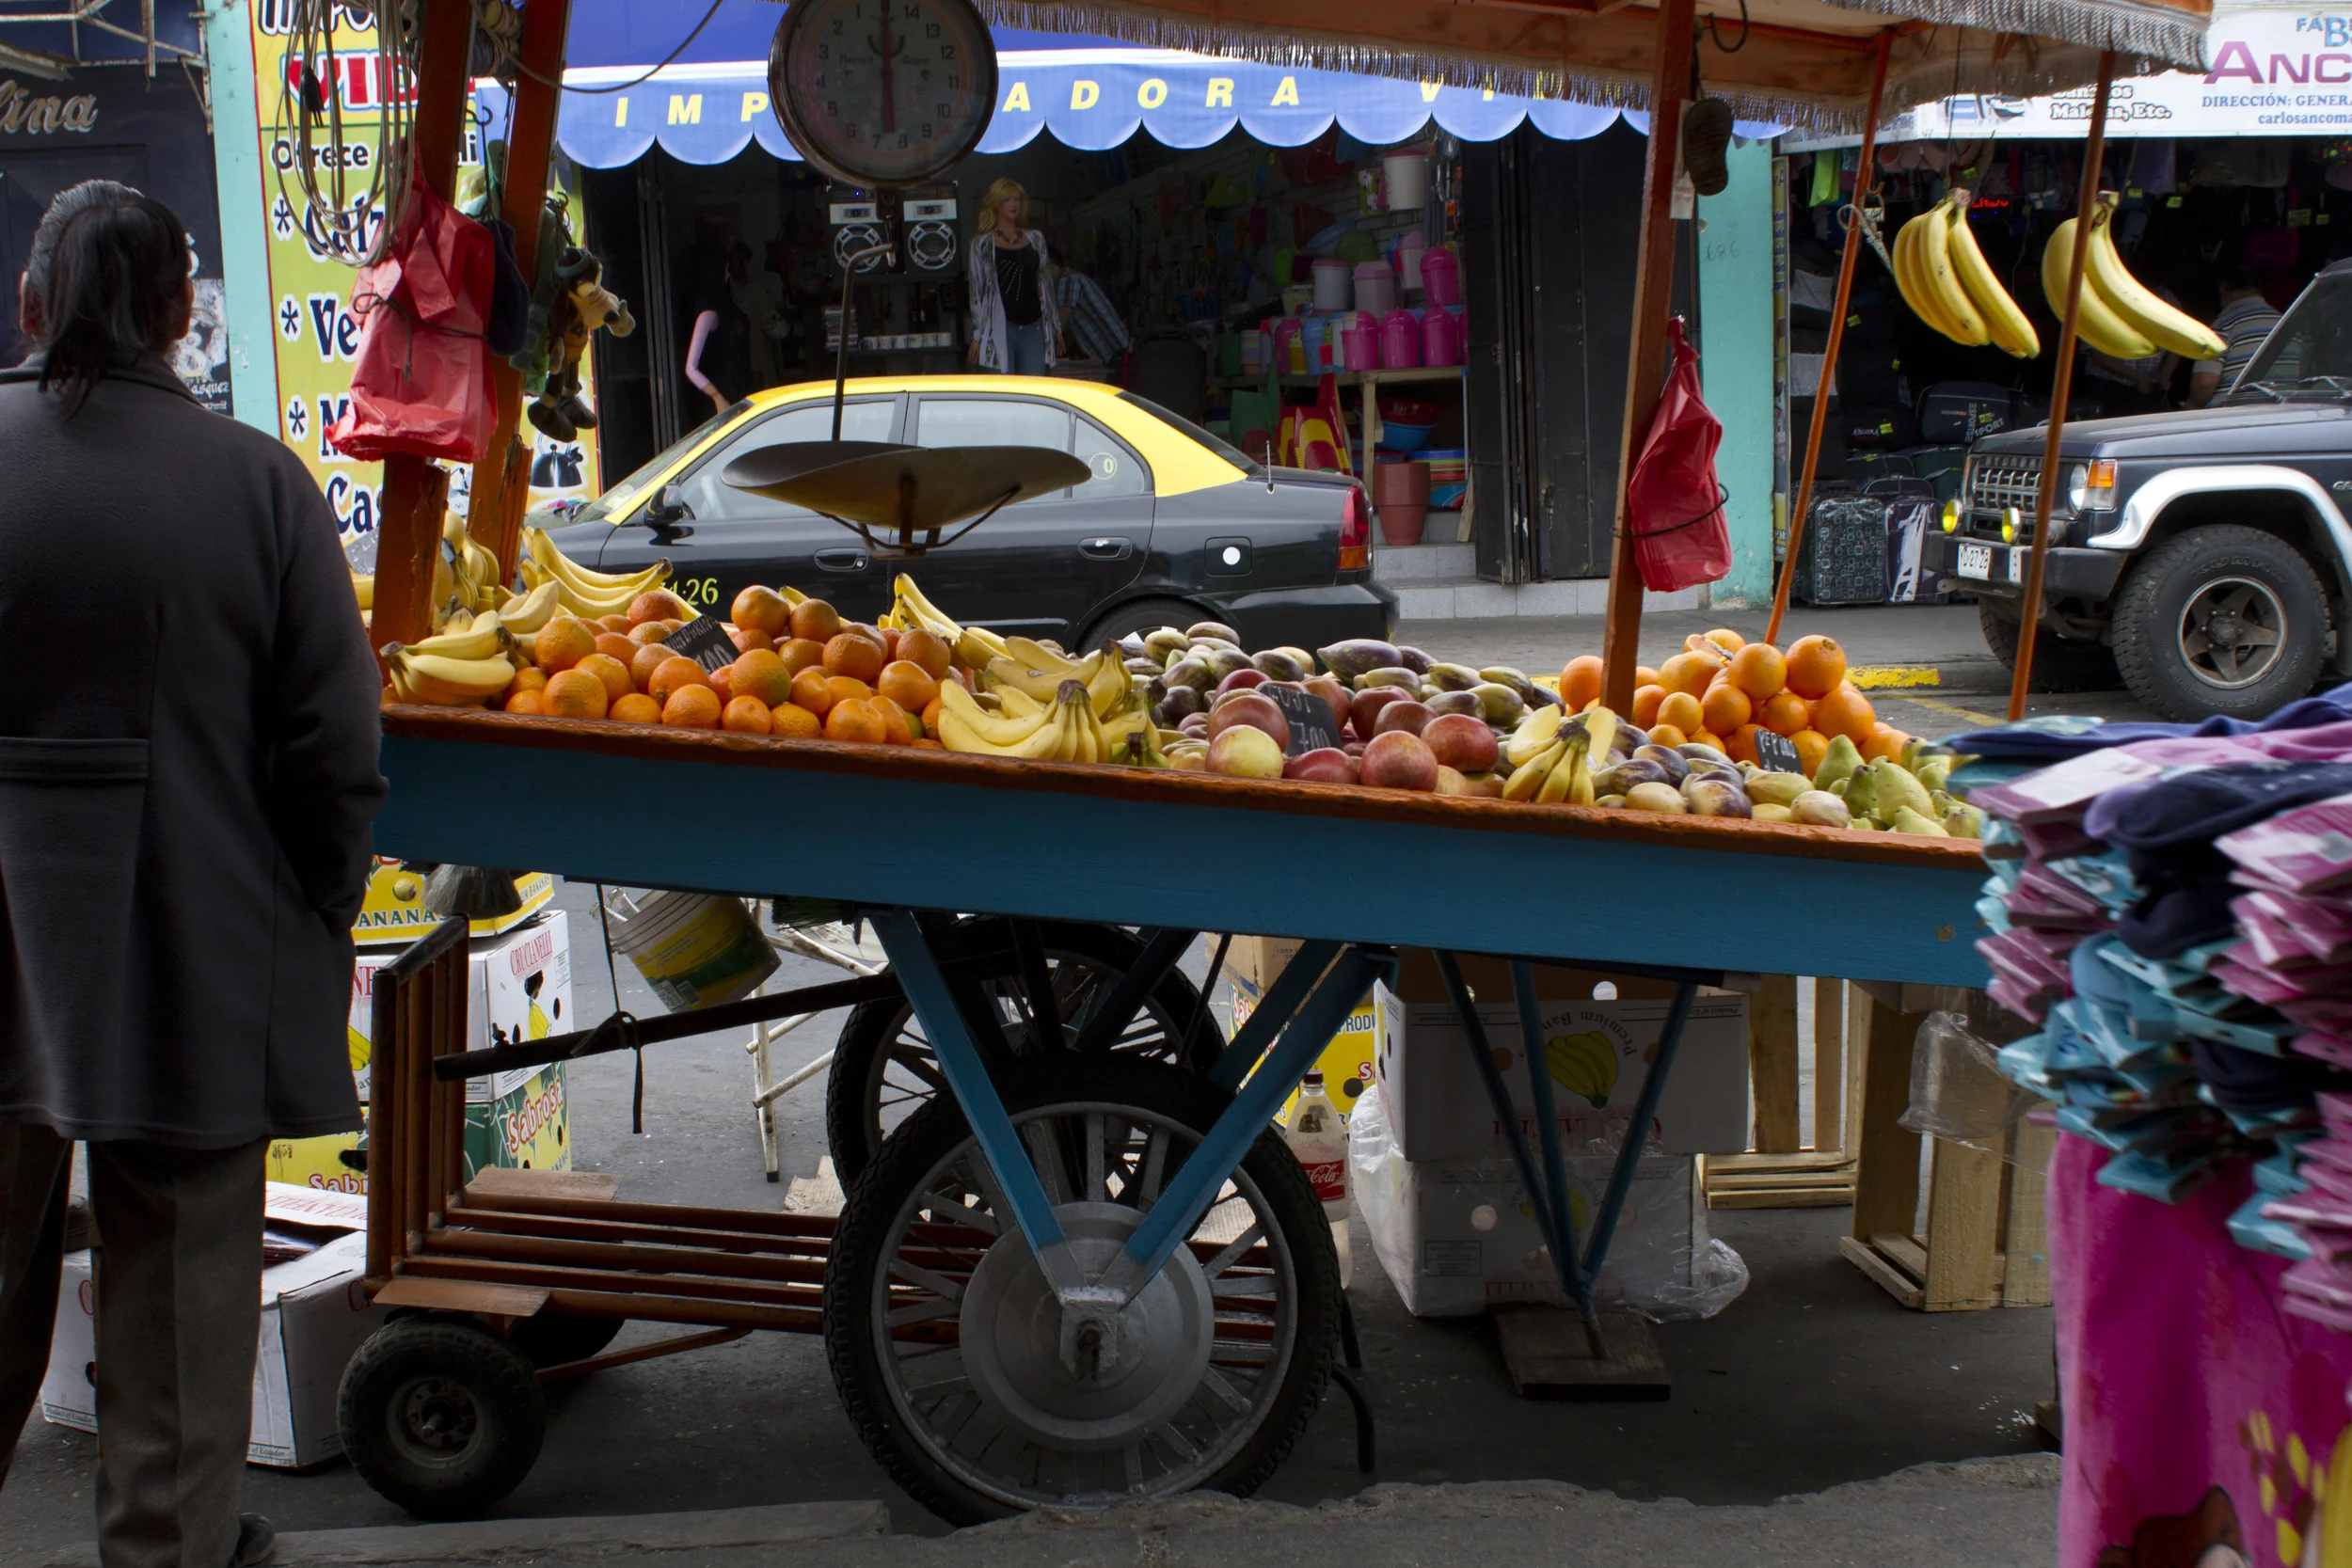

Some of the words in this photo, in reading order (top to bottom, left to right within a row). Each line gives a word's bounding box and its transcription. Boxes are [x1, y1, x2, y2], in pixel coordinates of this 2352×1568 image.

[904, 5, 920, 20] 14
[833, 21, 844, 36] 2
[926, 24, 940, 39] 13
[818, 45, 829, 59] 3
[940, 46, 955, 60] 12
[816, 75, 825, 88] 4
[948, 75, 960, 89] 11
[2201, 93, 2292, 107] DIRECCIÓN:
[827, 102, 837, 116] 5
[937, 103, 951, 119] 10
[2132, 103, 2172, 119] Etc.
[922, 123, 932, 137] 9
[872, 135, 882, 149] 7
[898, 135, 908, 149] 8
[310, 298, 363, 356] Ve
[191, 381, 230, 400] asquez
[327, 476, 382, 534] Ca
[358, 908, 447, 927] ANANA
[510, 929, 554, 976] CRUCIANELLI
[508, 1076, 564, 1154] Sabrosa
